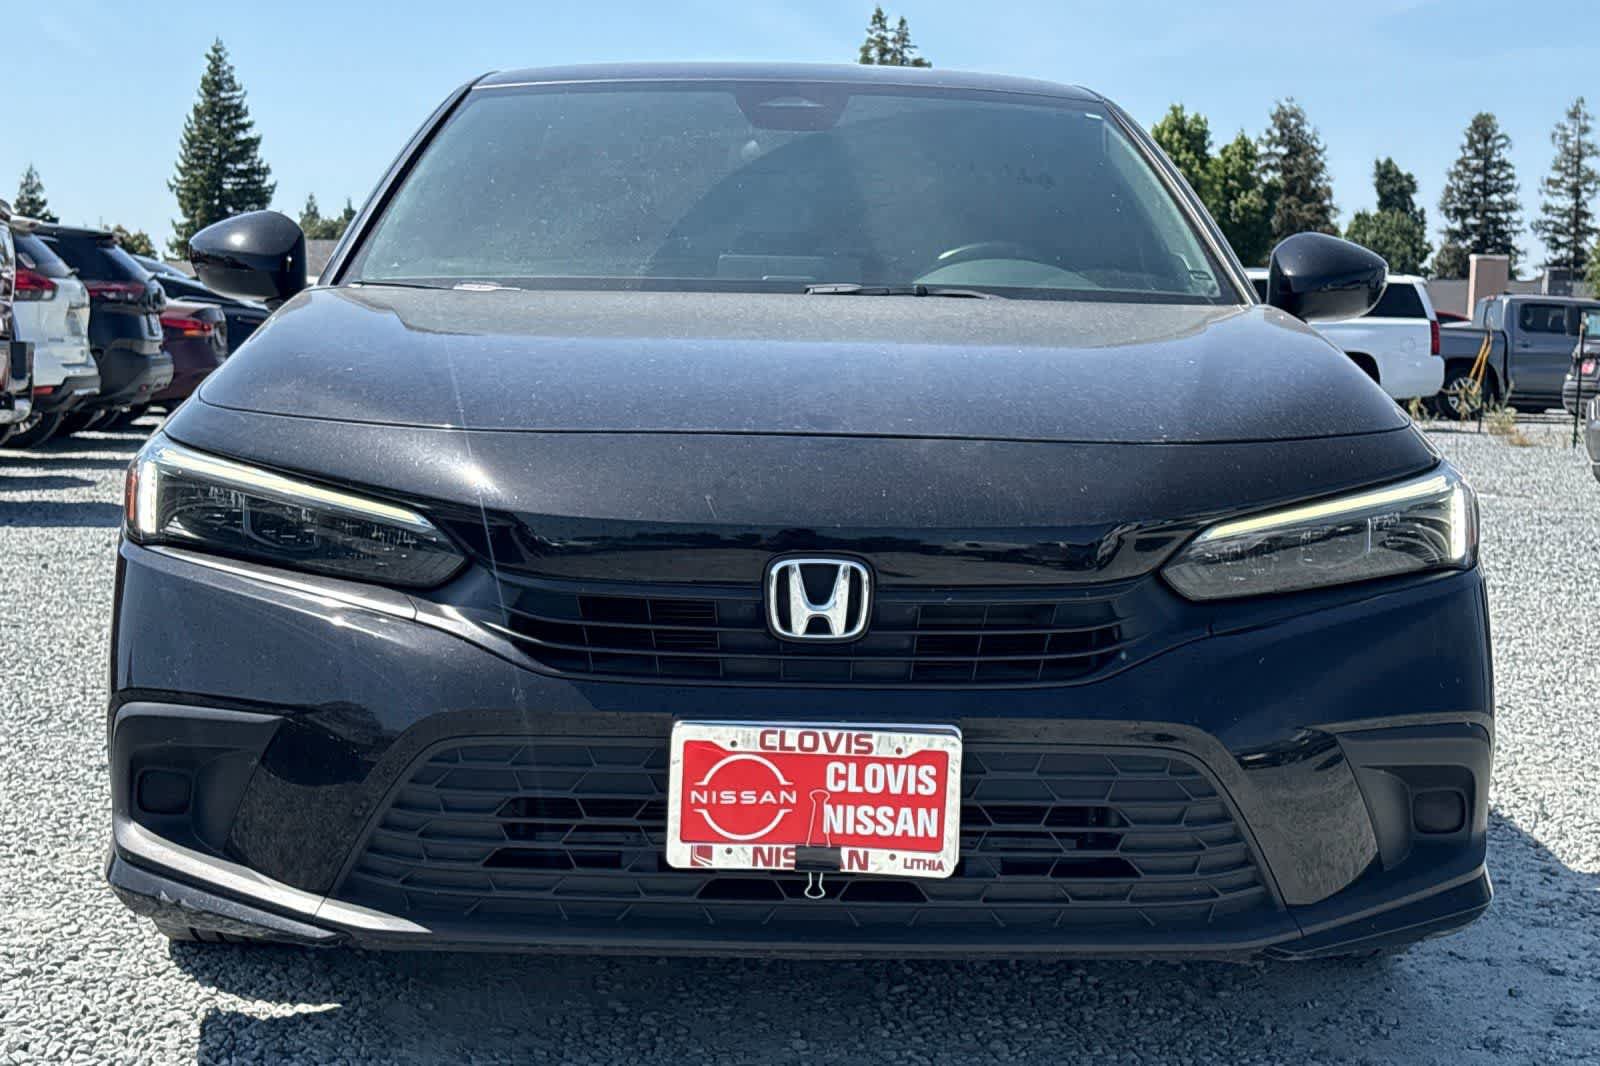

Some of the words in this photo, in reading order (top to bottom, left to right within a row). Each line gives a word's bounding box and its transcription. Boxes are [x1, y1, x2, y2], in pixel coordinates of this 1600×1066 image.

[760, 729, 874, 755] CLOVIS
[826, 761, 937, 795] CLOVIS
[691, 789, 797, 805] NISSAN
[824, 803, 938, 837] NISSAN
[752, 846, 869, 871] NISN
[903, 857, 945, 872] LITHIA
